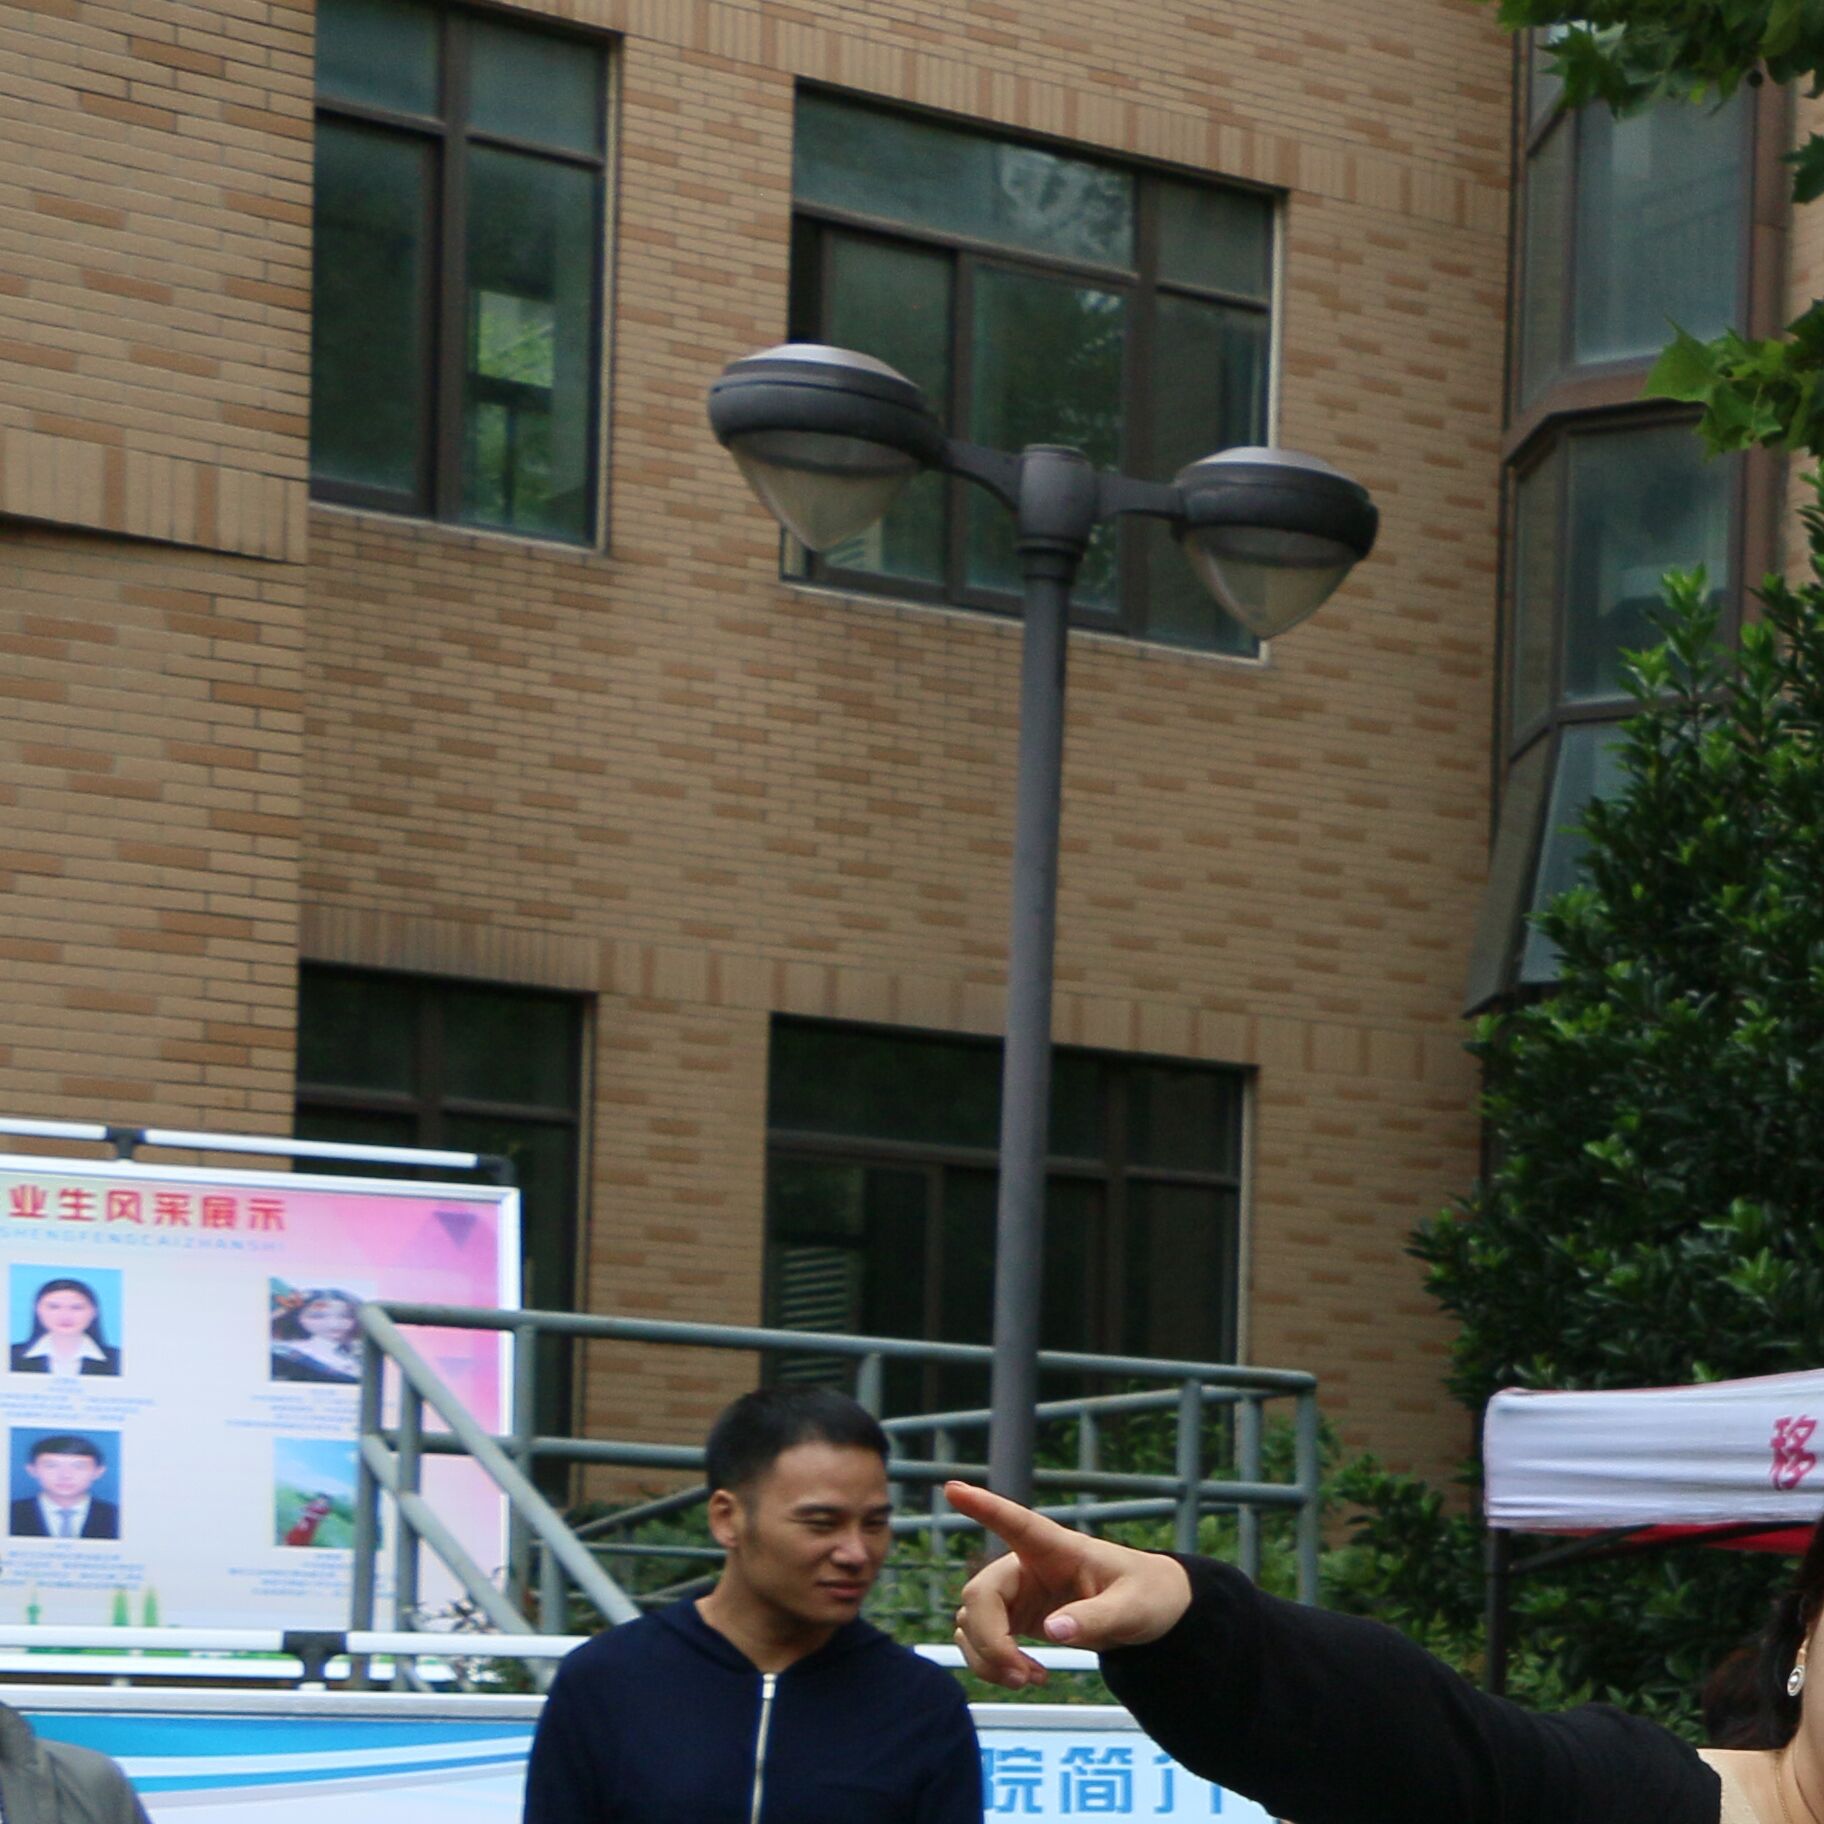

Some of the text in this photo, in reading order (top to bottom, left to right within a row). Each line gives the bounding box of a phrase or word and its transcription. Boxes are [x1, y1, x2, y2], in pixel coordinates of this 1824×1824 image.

[9, 1184, 286, 1231] 业生风采展示
